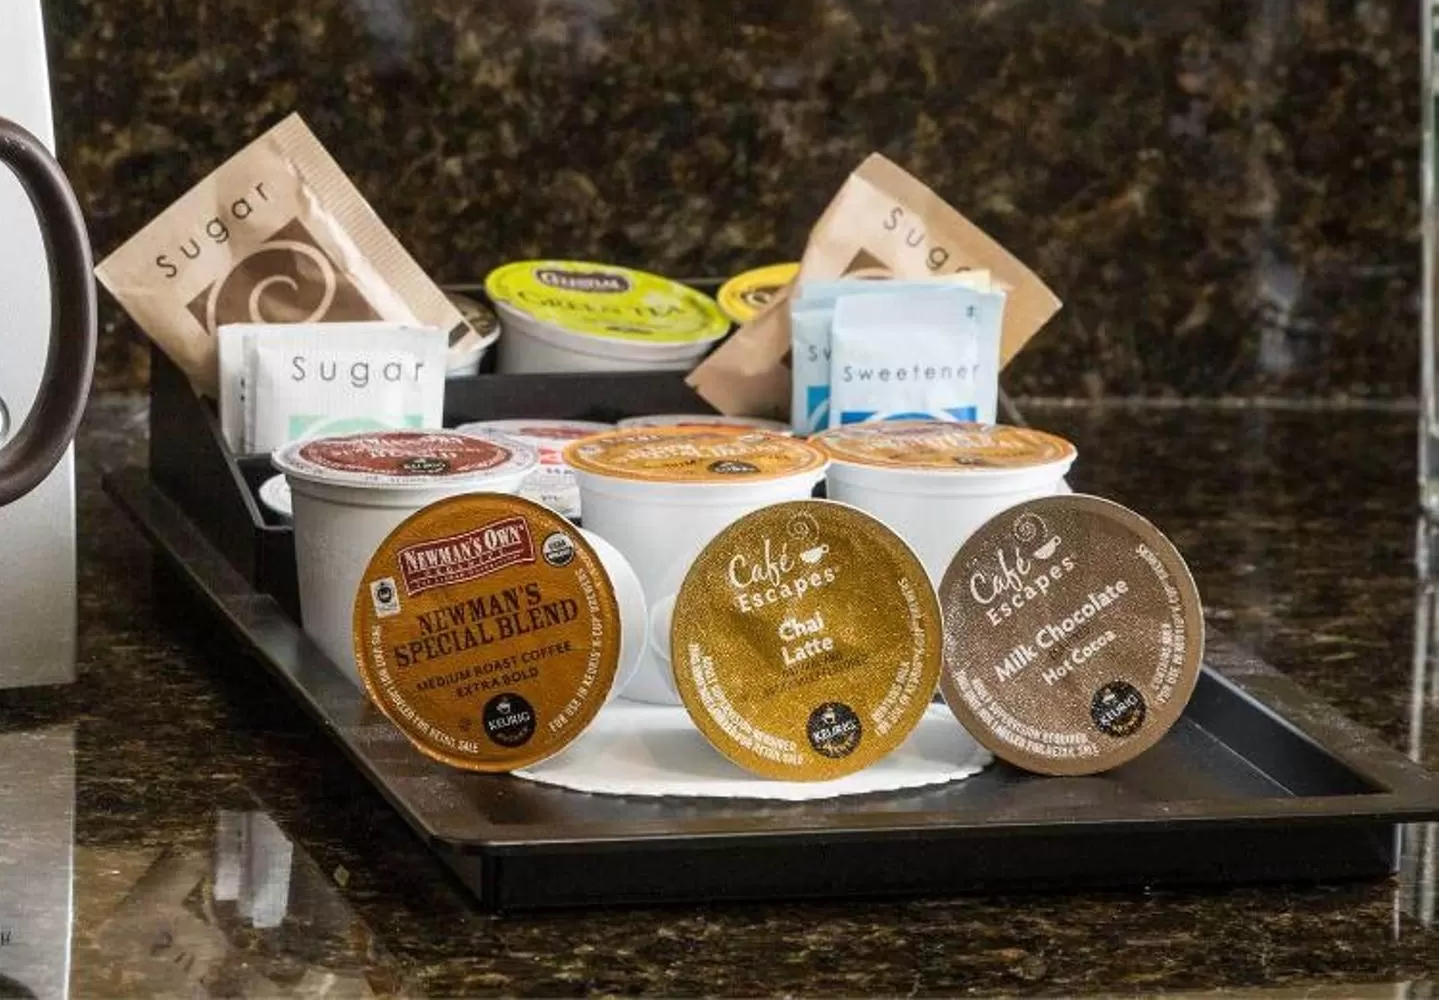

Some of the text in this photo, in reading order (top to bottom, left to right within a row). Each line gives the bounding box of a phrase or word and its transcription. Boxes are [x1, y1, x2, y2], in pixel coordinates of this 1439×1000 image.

[154, 179, 273, 280] Sugar
[291, 355, 427, 389] Sugar
[843, 363, 981, 383] Sweetener
[727, 536, 796, 589] Café
[969, 547, 1032, 604] Café
[416, 582, 543, 636] NEWMAN'S
[737, 567, 837, 613] Escapes
[986, 556, 1076, 626] Escapes
[393, 597, 580, 669] SPECIAL BLEND
[777, 610, 825, 641] Chai
[782, 636, 834, 667] Latte
[993, 579, 1129, 683] Milk Chocolate
[416, 639, 573, 691] MEDIUM ROAST COFFEE
[456, 667, 540, 698] EXTRA BOLD
[1041, 629, 1119, 687] Hot Cocoa
